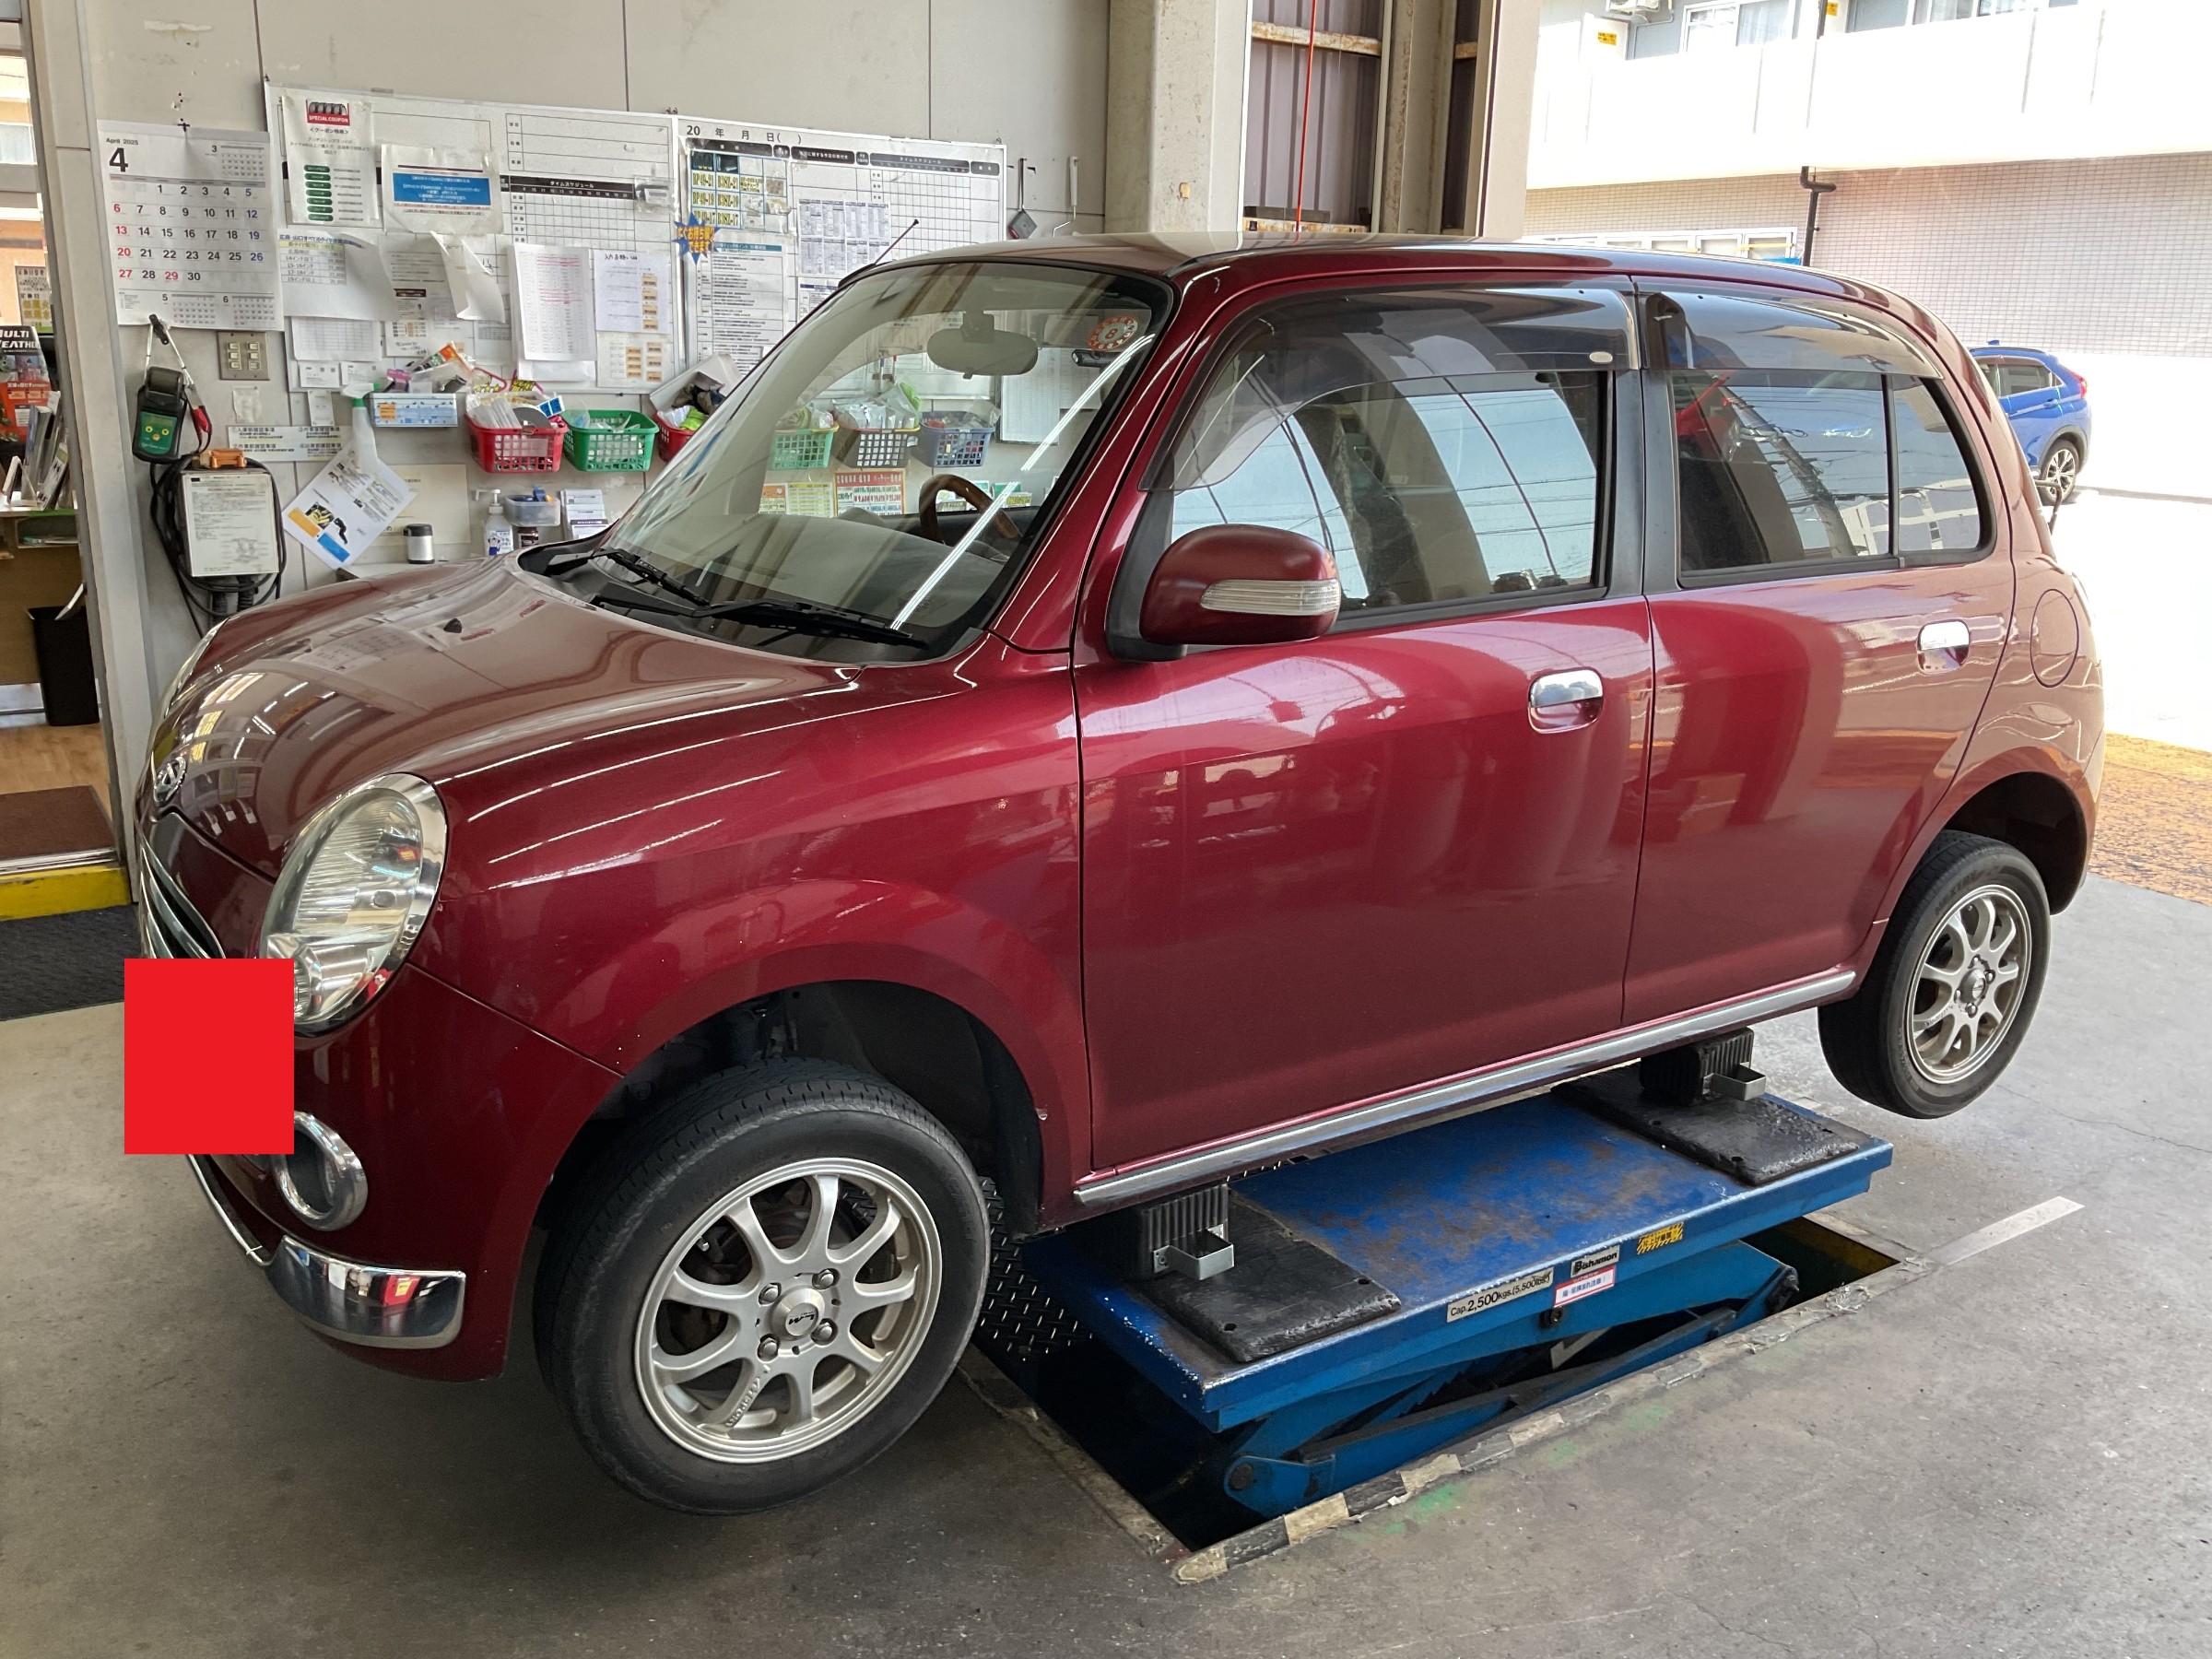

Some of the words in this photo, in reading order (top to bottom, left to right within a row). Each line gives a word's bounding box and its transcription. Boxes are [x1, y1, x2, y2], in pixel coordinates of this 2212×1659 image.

[686, 125, 700, 135] 20
[715, 128, 724, 138] 年
[741, 131, 749, 140] 月
[211, 145, 218, 153] 3
[109, 147, 129, 172] 4
[158, 184, 162, 194] 1
[181, 186, 187, 195] 2
[203, 186, 208, 195] 3
[223, 187, 230, 195] 4
[245, 188, 252, 197] 5
[113, 203, 121, 213] 6
[136, 205, 144, 214] 7
[159, 206, 166, 216] 8
[182, 207, 189, 217] 9
[205, 208, 216, 218] 10
[225, 209, 235, 218] 11
[247, 209, 258, 218] 12
[116, 226, 127, 234] 13
[138, 227, 149, 236] 14
[161, 229, 173, 238] 15
[184, 229, 195, 238] 16
[206, 230, 217, 239] 17
[227, 230, 238, 240] 18
[249, 231, 260, 240] 19
[118, 247, 131, 256] 20
[140, 249, 152, 257] 21
[163, 250, 177, 259] 22
[186, 251, 199, 260] 23
[207, 252, 219, 260] 24
[229, 253, 241, 261] 25
[251, 253, 264, 262] 26
[120, 269, 133, 278] 27
[142, 270, 155, 279] 28
[165, 271, 179, 280] 29
[188, 272, 201, 280] 30
[223, 295, 229, 303] 6
[1572, 1252, 1618, 1275] Bishamon
[1451, 1306, 1466, 1316] Cap.
